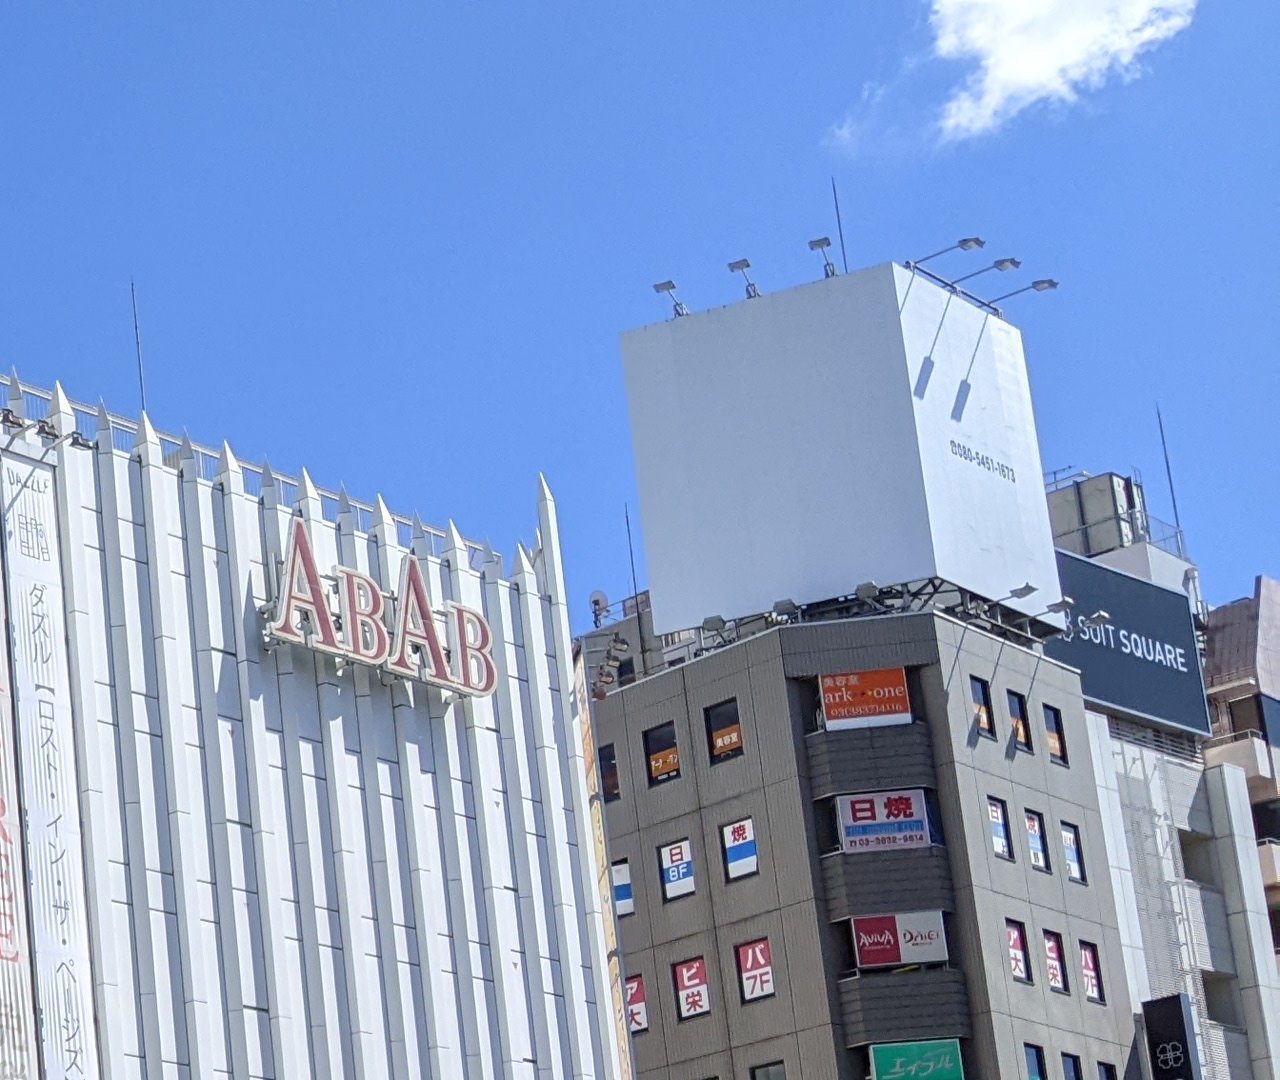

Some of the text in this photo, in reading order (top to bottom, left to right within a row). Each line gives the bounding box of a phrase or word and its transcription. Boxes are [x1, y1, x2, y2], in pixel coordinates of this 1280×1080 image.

[267, 517, 497, 698] ABAB
[1078, 615, 1188, 673] SUIT SQUARE
[825, 685, 905, 704] ark one
[850, 795, 914, 823] 日焼
[669, 865, 688, 880] 8F
[682, 962, 700, 986] ビ
[746, 944, 766, 969] バ
[746, 972, 771, 995] 7F
[685, 990, 704, 1012] 栄
